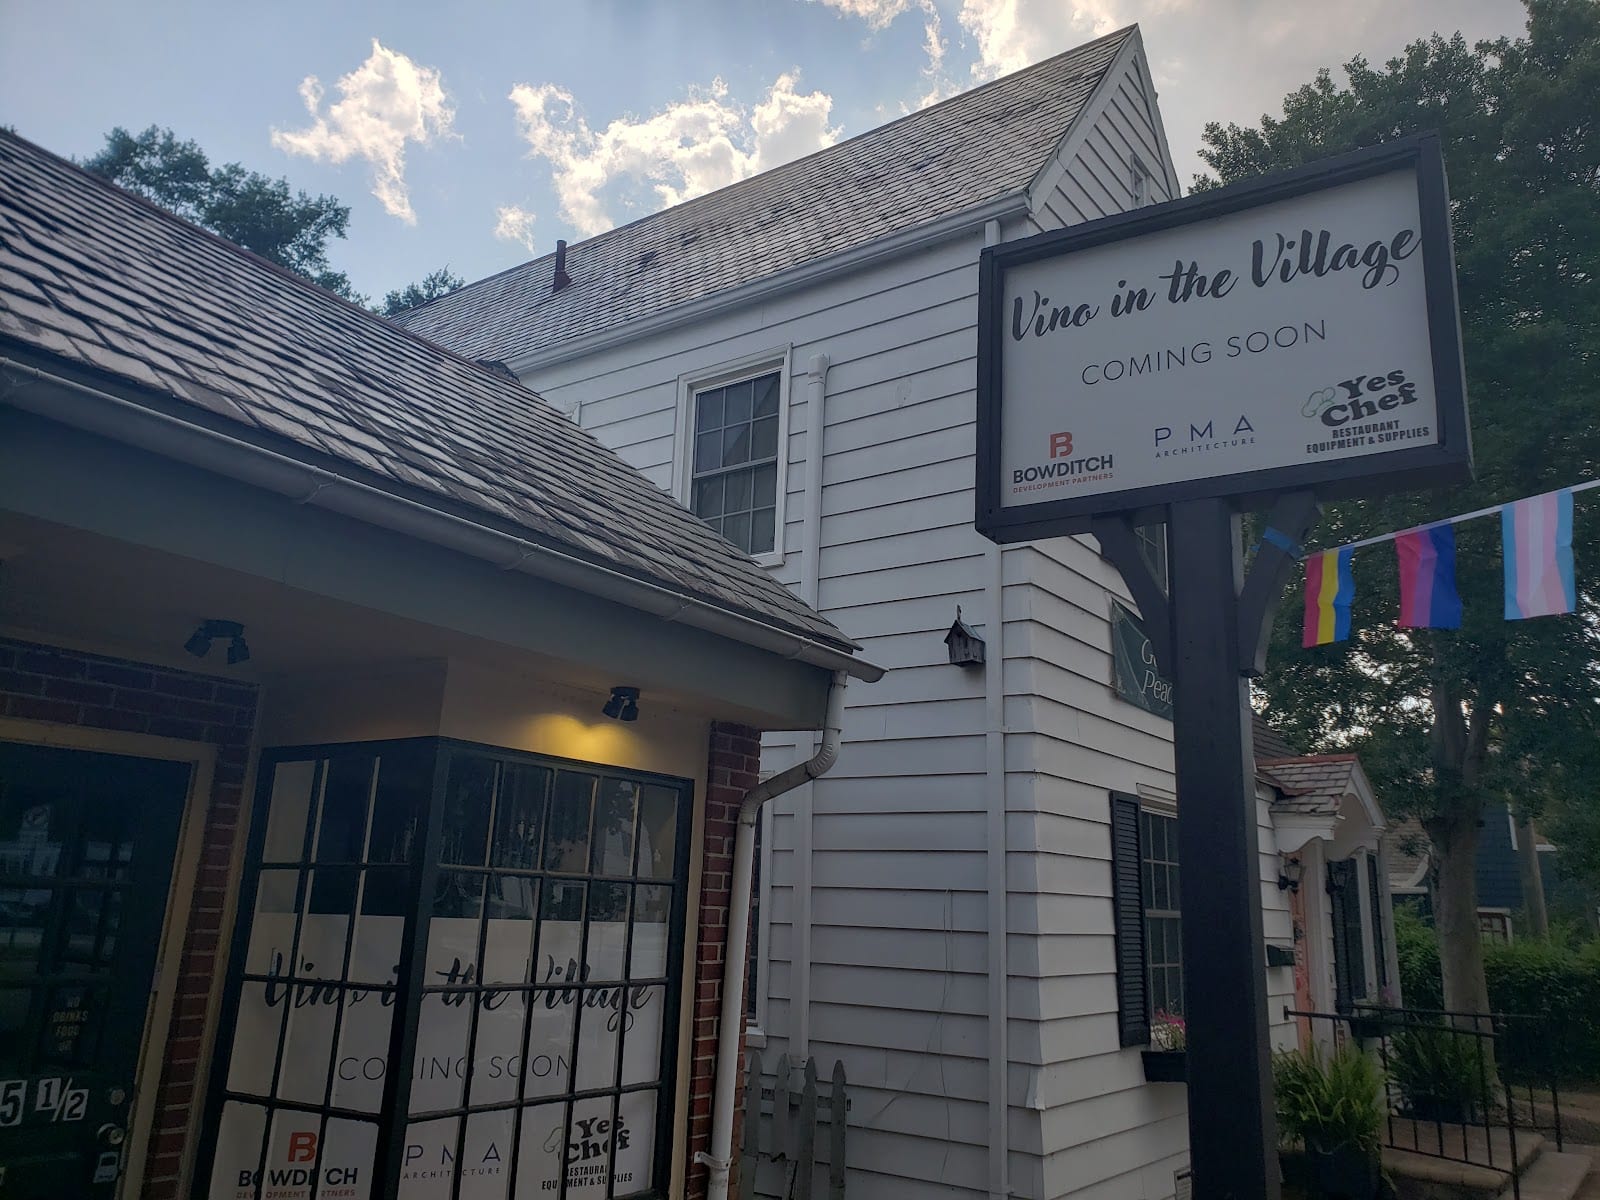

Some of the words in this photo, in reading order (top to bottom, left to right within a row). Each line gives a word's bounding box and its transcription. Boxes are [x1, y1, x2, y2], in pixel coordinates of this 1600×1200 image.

[1012, 290, 1100, 341] Vino
[1111, 280, 1156, 318] in
[1159, 260, 1239, 304] the
[1252, 229, 1423, 290] Village
[1082, 342, 1212, 385] COMING
[1227, 320, 1326, 358] SOON
[1337, 369, 1405, 399] Yes
[1321, 382, 1418, 427] Chef
[1306, 437, 1366, 454] EQUIPMENT
[1368, 436, 1376, 445] &
[1378, 426, 1430, 443] SUPPLIES
[1332, 420, 1400, 439] RESTAURANT
[1155, 437, 1256, 458] ARCHITECTURE
[1013, 454, 1114, 484] BOWDITCH
[1013, 478, 1070, 494] DEVELOPMENT
[1072, 472, 1114, 485] PARTNERS
[265, 953, 369, 1008] Vin
[338, 1056, 466, 1081] COIN
[575, 1116, 624, 1139] Yes
[238, 1167, 358, 1187] BOWDICH
[403, 1167, 501, 1180] ARCHITCTURE
[569, 1165, 606, 1178] ESTAURA
[236, 1190, 307, 1199] DEVOPMENT
[321, 1188, 356, 1198] RTNERS
[542, 1177, 588, 1190] EQUMENT
